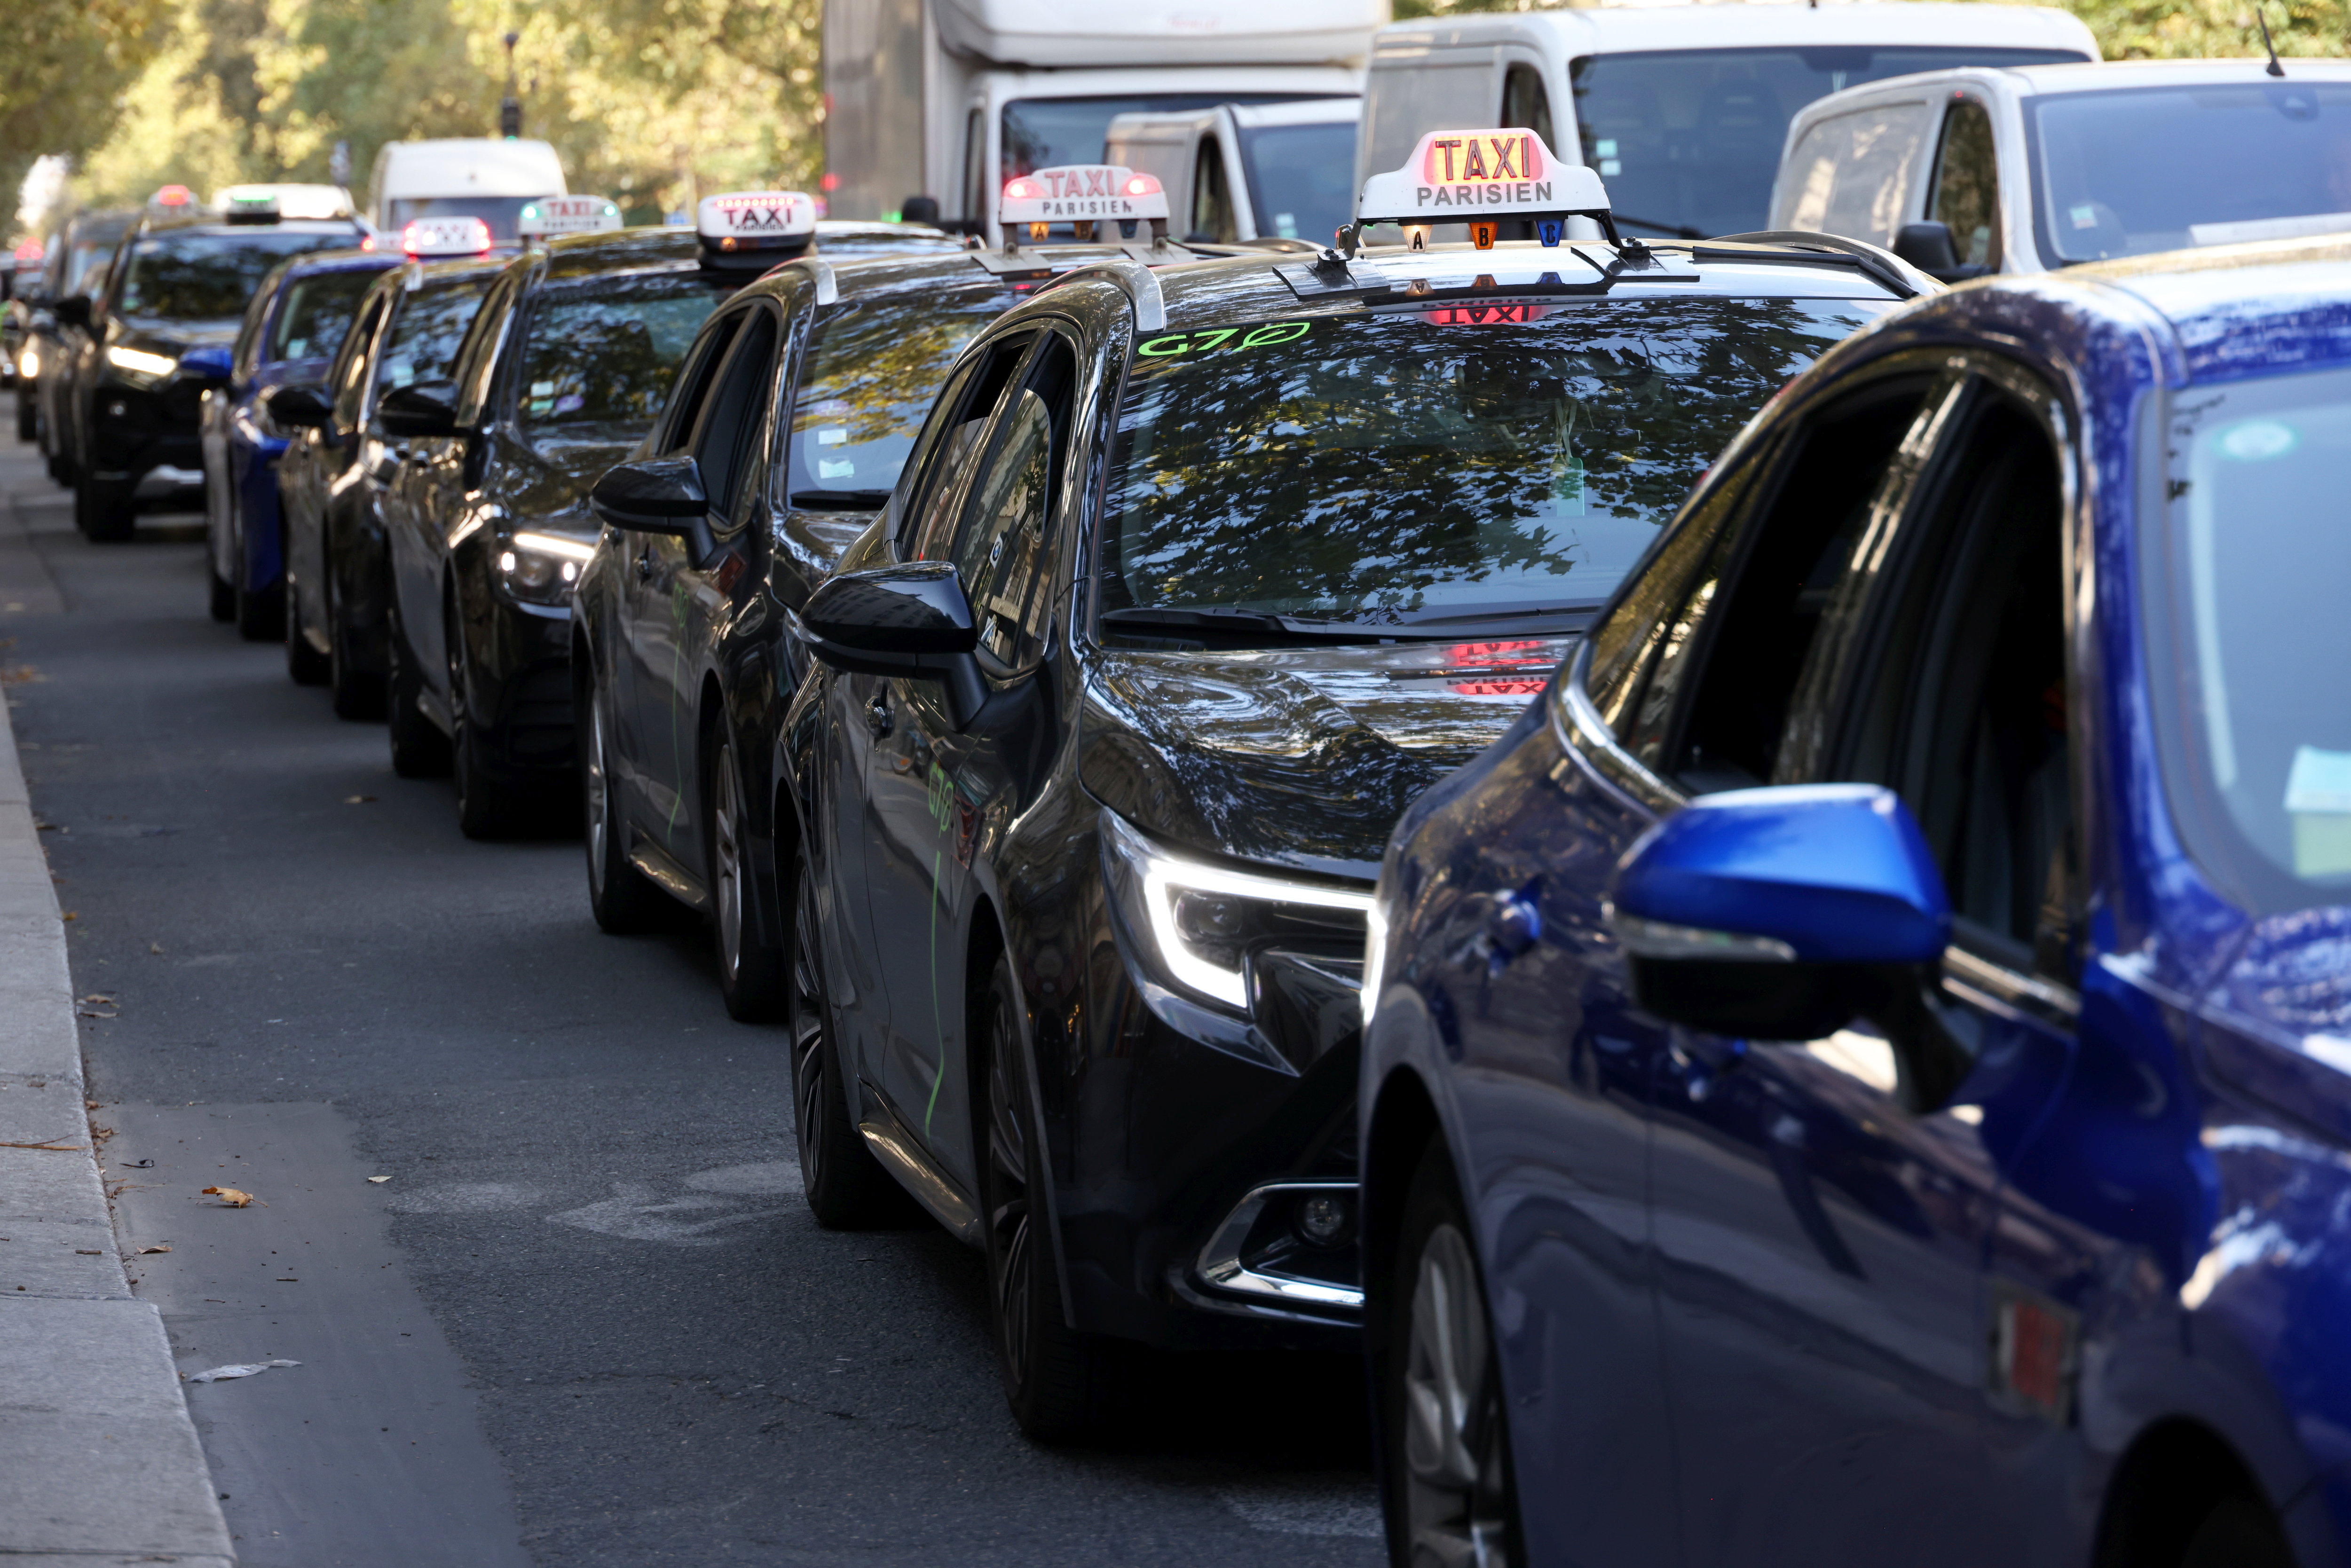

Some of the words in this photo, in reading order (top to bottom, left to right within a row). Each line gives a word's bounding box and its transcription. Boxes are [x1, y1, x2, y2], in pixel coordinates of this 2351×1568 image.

[1435, 137, 1530, 181] TAXI
[1044, 169, 1115, 198] TAXI
[1417, 181, 1552, 206] PARISIEN
[548, 200, 591, 216] TAXI
[723, 208, 792, 225] TAXI
[1043, 199, 1132, 215] PARISIEN
[1413, 231, 1423, 250] A
[1479, 228, 1489, 246] B
[1546, 224, 1555, 244] C
